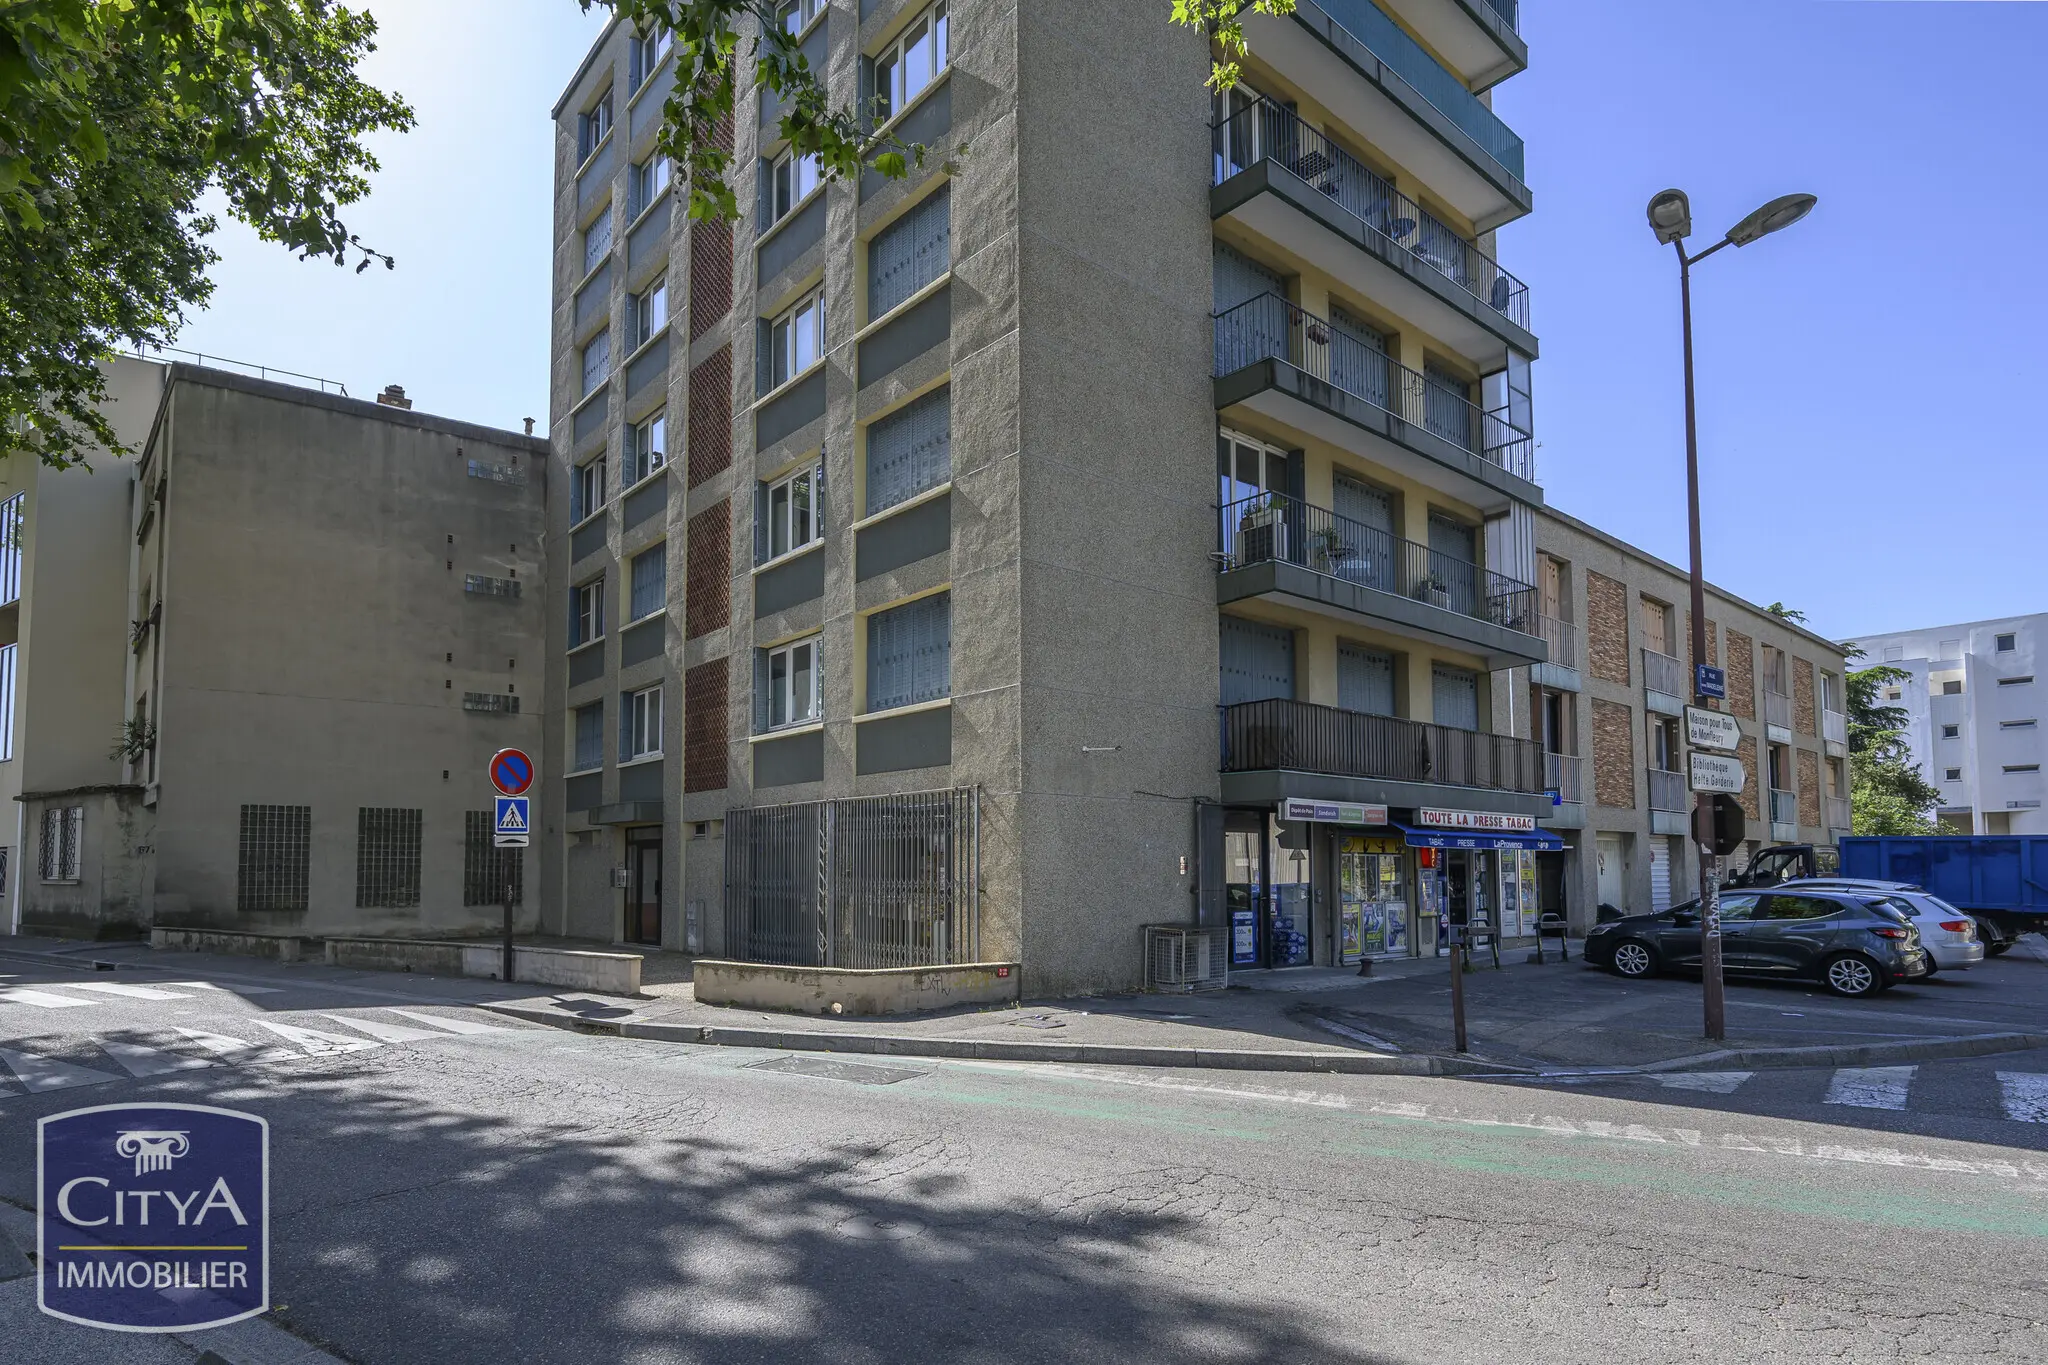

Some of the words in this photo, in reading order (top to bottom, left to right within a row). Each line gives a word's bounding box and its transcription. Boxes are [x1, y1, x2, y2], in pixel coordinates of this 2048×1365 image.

[1690, 711, 1708, 726] Maison
[1709, 718, 1720, 729] pour
[1721, 718, 1733, 731] Tous
[1691, 727, 1697, 739] de
[1711, 774, 1734, 788] Garderie
[1422, 811, 1452, 824] TOUTE
[1456, 814, 1469, 826] LA
[1474, 815, 1503, 827] PRESSE
[1506, 817, 1532, 829] TABAC
[1428, 838, 1444, 846] TABAC
[1457, 839, 1476, 847] PRESSE
